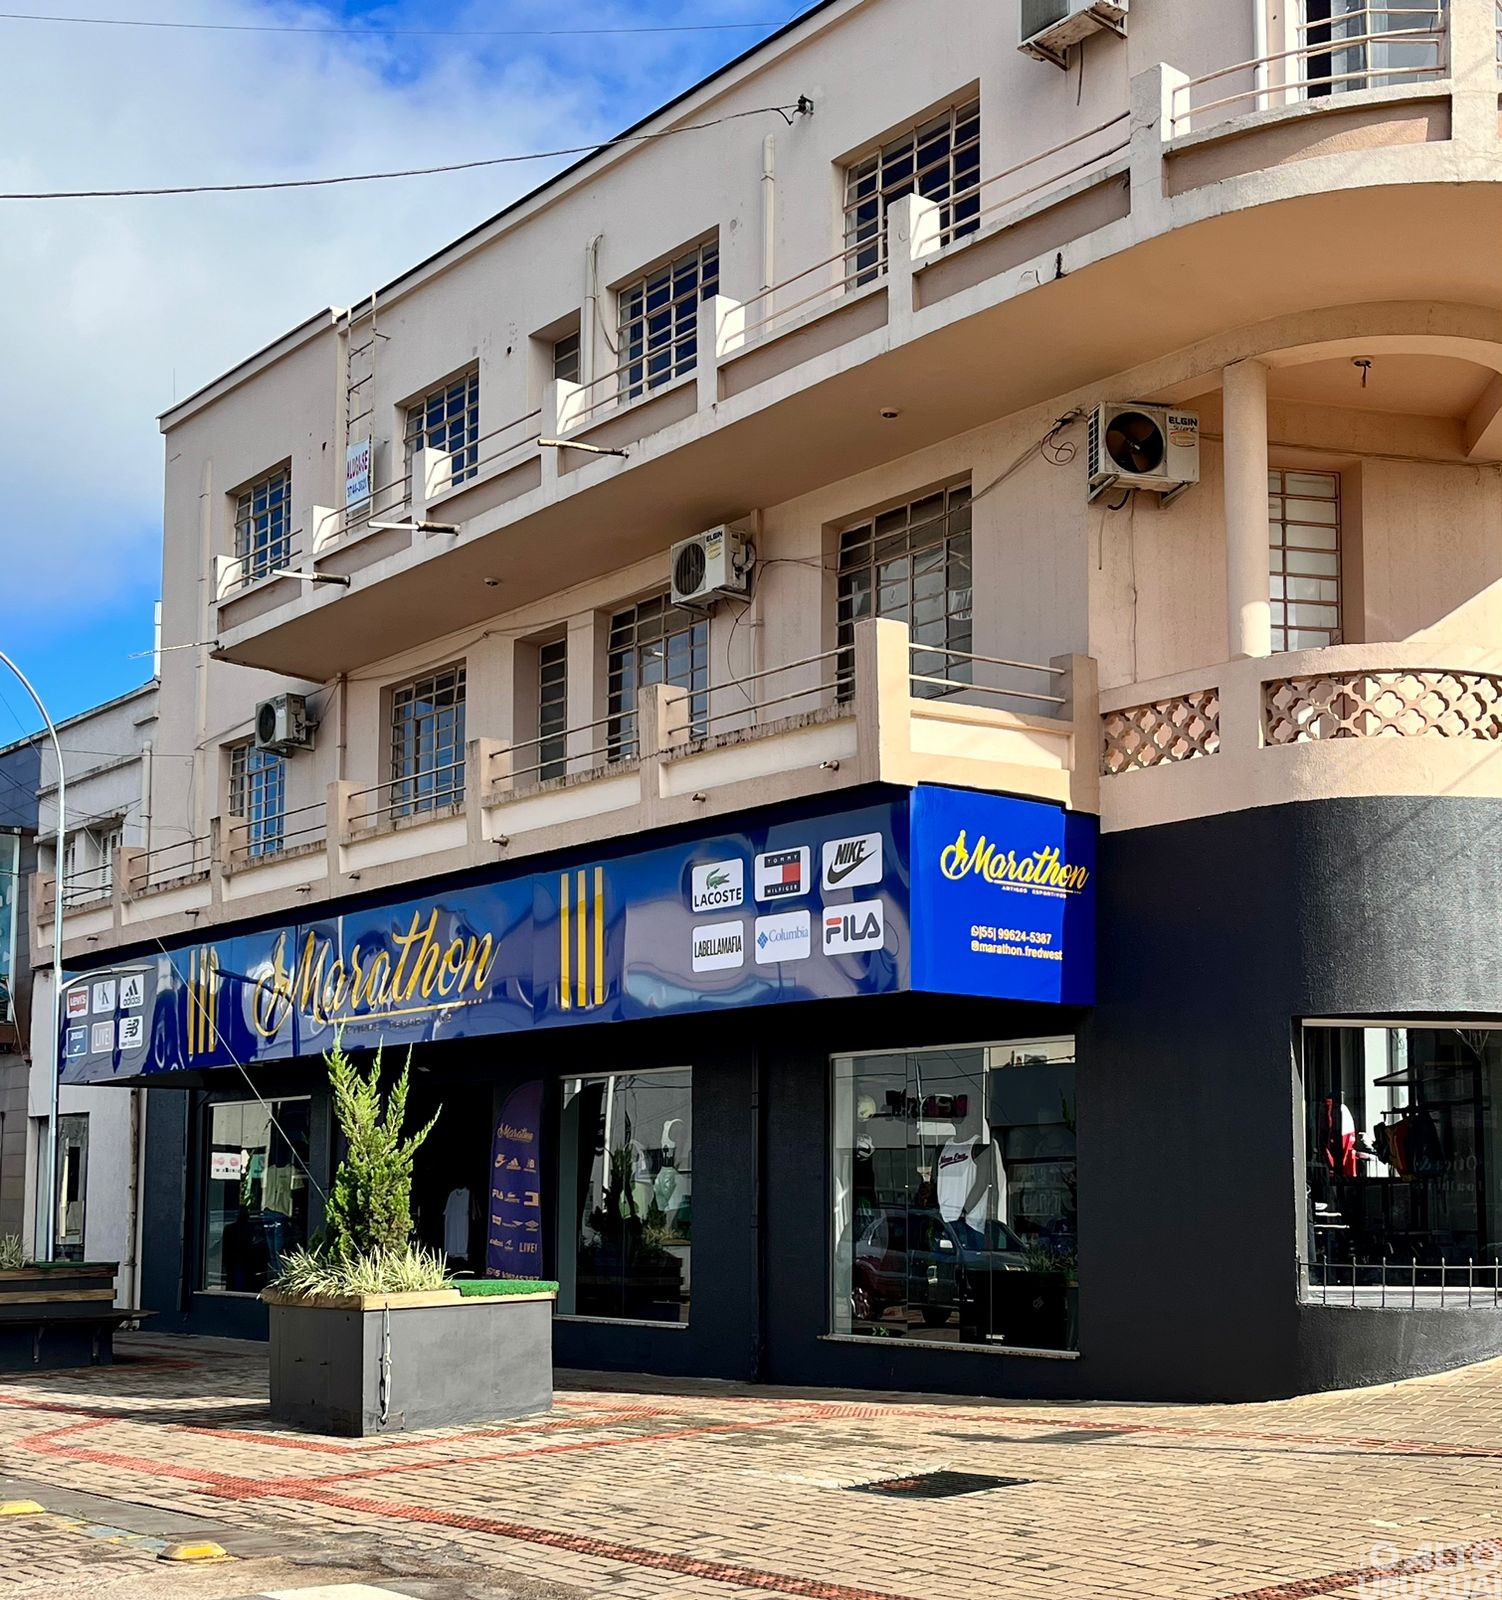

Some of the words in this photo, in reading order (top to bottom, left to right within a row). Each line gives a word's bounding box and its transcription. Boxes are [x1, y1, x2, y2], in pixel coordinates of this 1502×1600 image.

[1168, 416, 1198, 427] ELGIN
[706, 531, 723, 542] ELGIN
[767, 854, 798, 864] TOMMY
[834, 840, 867, 866] NIKE
[941, 830, 1089, 889] Marathon
[694, 888, 742, 908] LACOSTE
[767, 884, 798, 895] HILFIGER
[768, 928, 809, 943] Columbia
[825, 912, 881, 944] FILA
[998, 928, 1052, 945] 99624-5387
[694, 935, 742, 958] LABELLAMAFIA
[253, 907, 501, 1037] Marathon
[123, 996, 141, 1006] adidas
